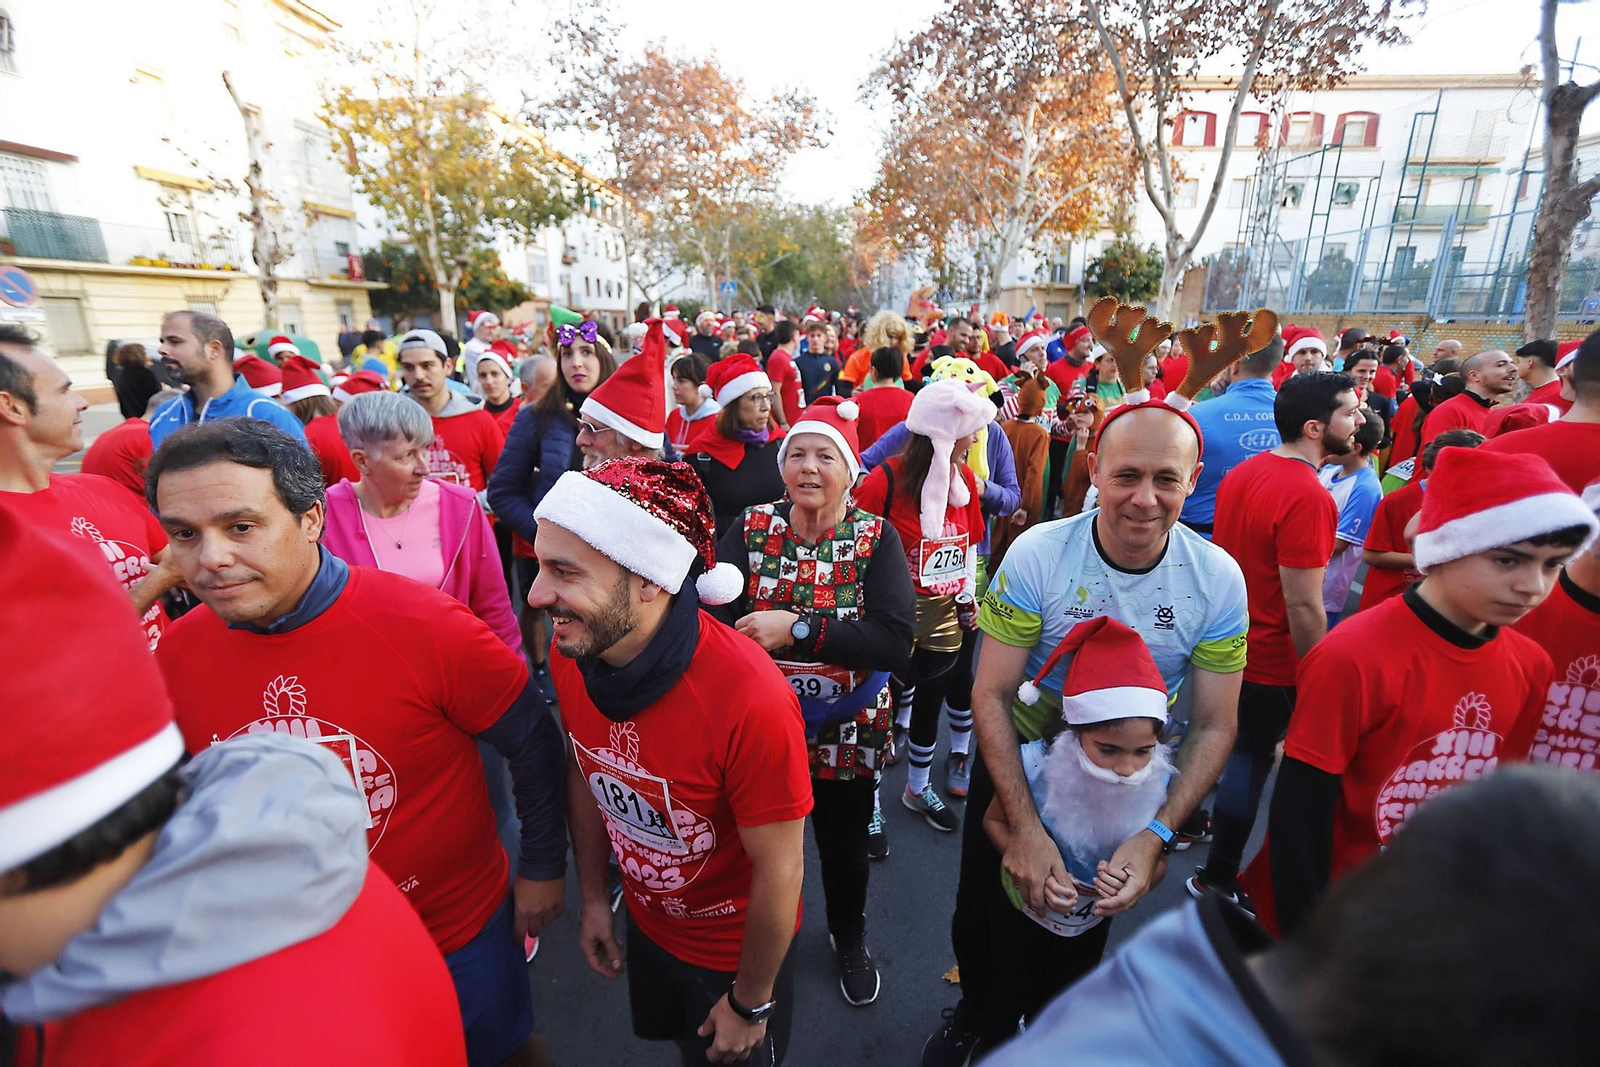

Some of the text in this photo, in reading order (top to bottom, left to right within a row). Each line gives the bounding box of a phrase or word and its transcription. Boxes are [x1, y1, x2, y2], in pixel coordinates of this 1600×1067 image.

[1224, 412, 1275, 421] C.D.A. COR
[1247, 433, 1278, 447] KIA
[1350, 518, 1362, 534] 3
[934, 548, 960, 569] 275
[791, 678, 821, 697] 39
[1431, 730, 1496, 757] XIII
[596, 775, 644, 823] 181
[1379, 782, 1427, 804] SAN
[611, 841, 685, 890] 2023
